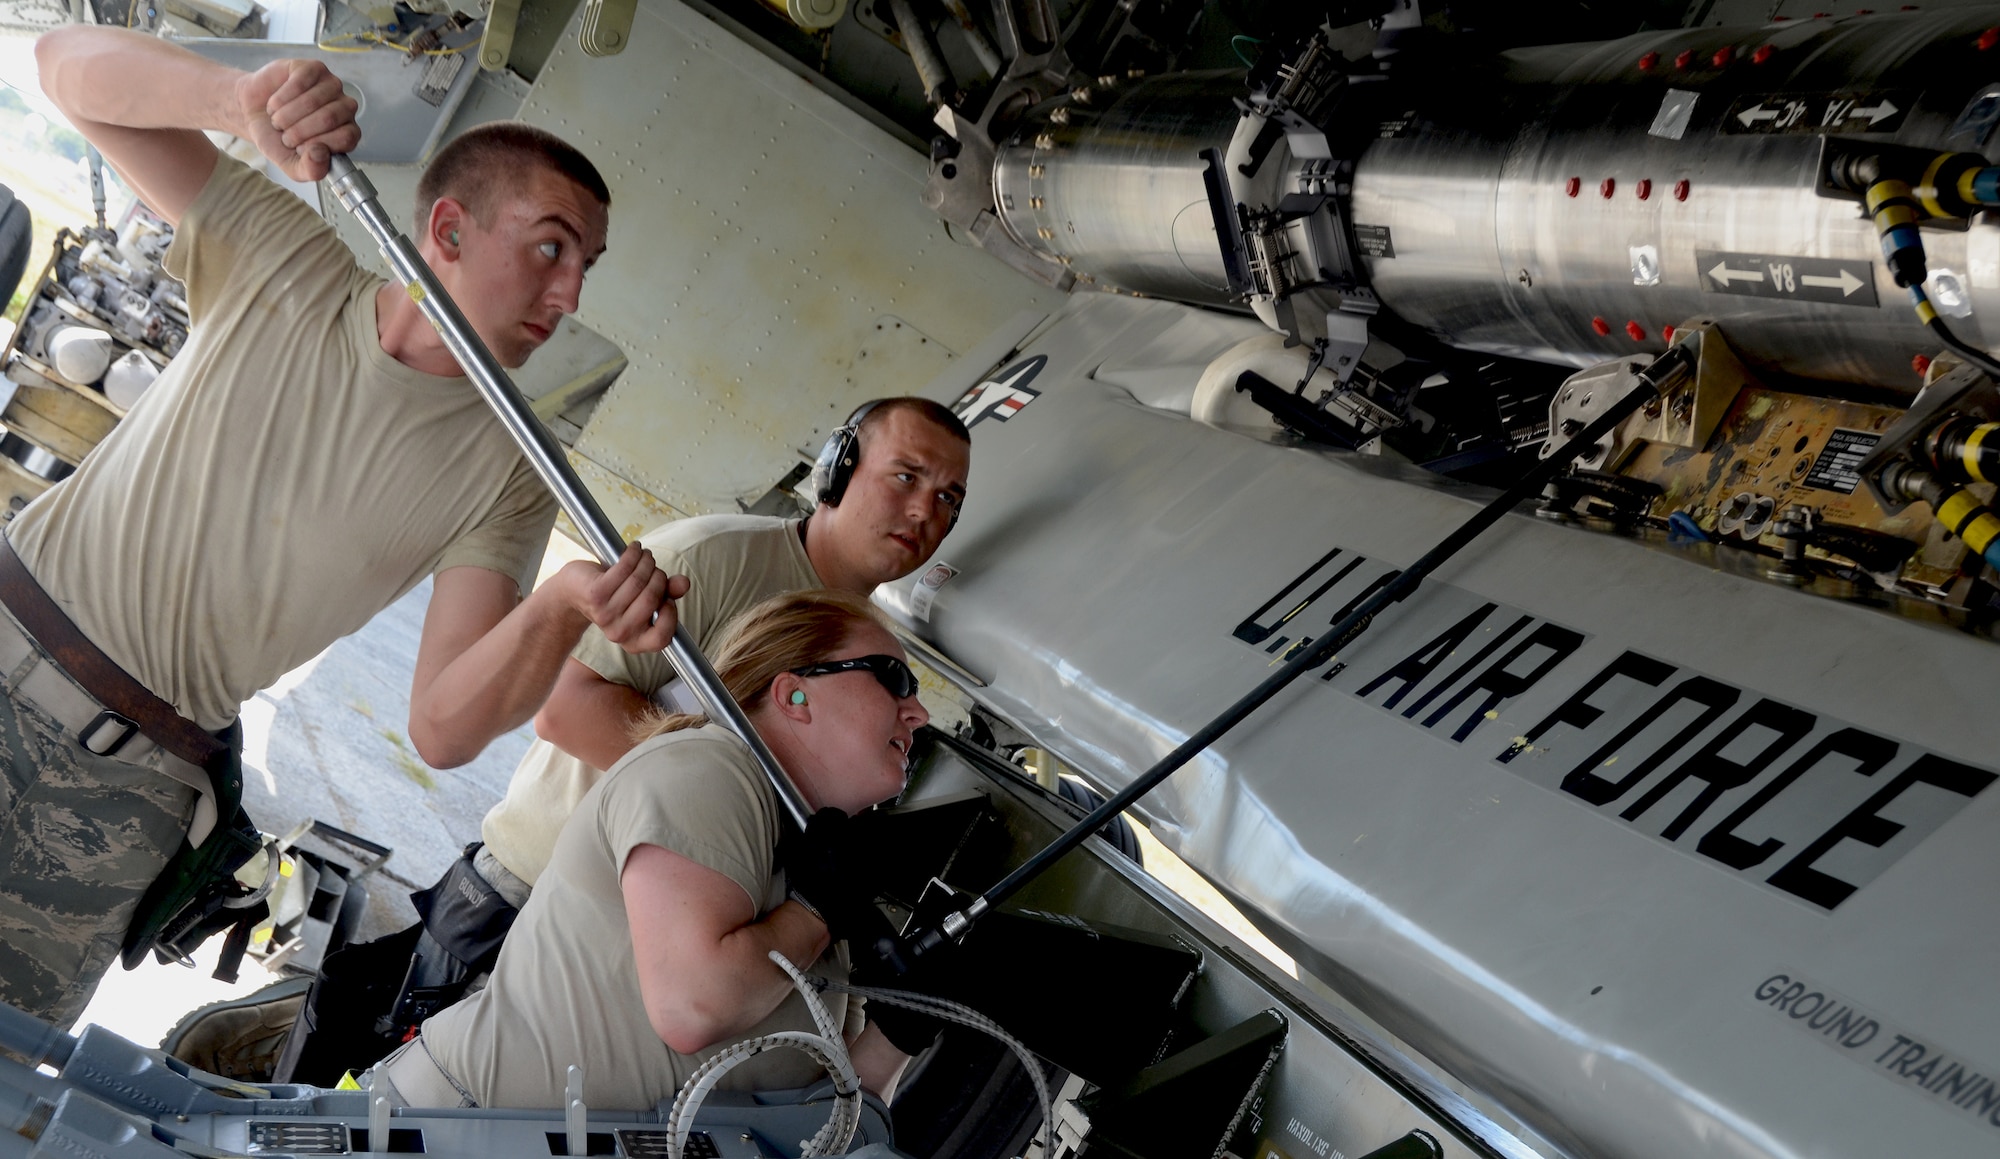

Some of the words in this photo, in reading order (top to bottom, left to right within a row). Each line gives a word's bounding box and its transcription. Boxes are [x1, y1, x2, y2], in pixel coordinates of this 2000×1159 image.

[1775, 100, 1808, 128] 4C
[1821, 99, 1855, 127] 7A
[1768, 263, 1796, 293] 8A
[1356, 603, 1586, 743] AIR
[1496, 654, 1999, 911] FORCE
[459, 876, 488, 908] BUNDY
[1755, 974, 1880, 1048] GROUND
